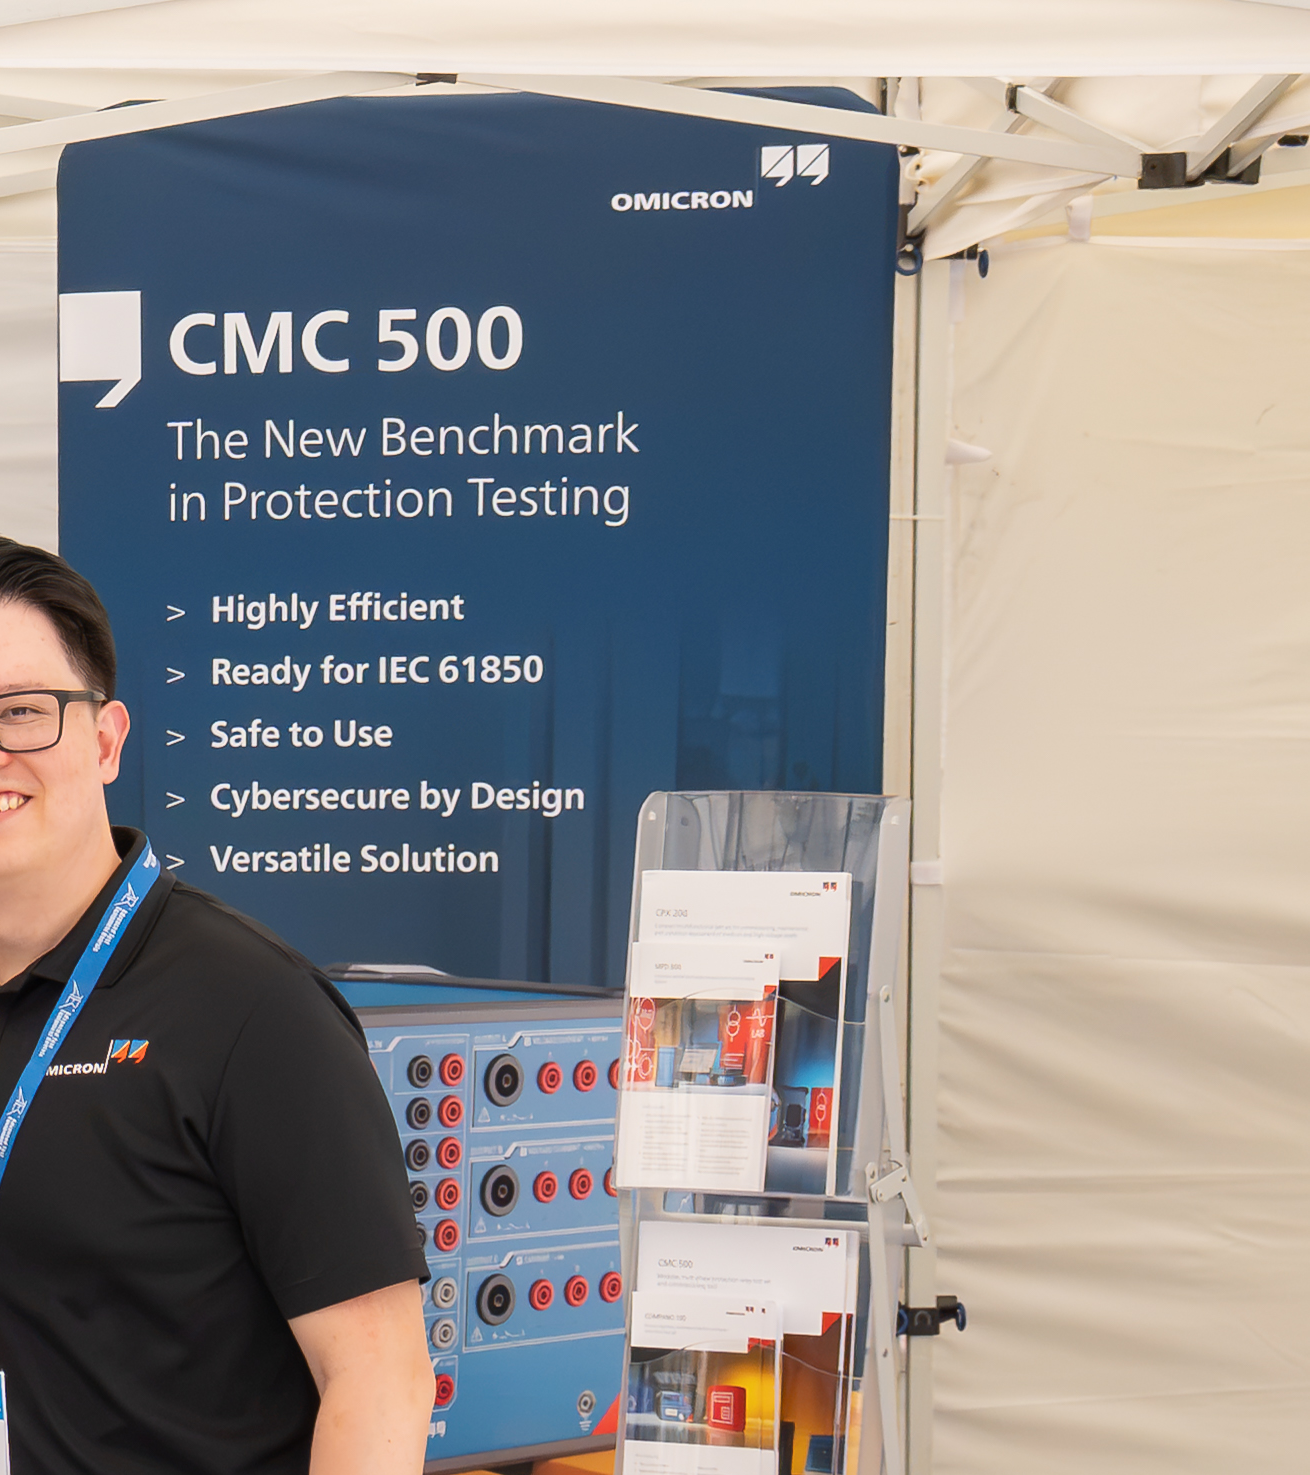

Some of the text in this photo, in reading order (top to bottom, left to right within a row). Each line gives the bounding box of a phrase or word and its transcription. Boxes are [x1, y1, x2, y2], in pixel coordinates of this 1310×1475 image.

[610, 189, 753, 212] OMICRON
[169, 305, 524, 375] CMC 500
[168, 411, 640, 460] The New Benchmark
[169, 477, 631, 527] in Protection Testing
[211, 592, 465, 629] Highly Efficient
[211, 655, 543, 692] Ready for IEC 61850
[211, 719, 393, 748] Safe to Use
[210, 781, 585, 818] Cybersecure by Design
[210, 844, 499, 873] Versatile Solution
[46, 1063, 104, 1076] MICRON
